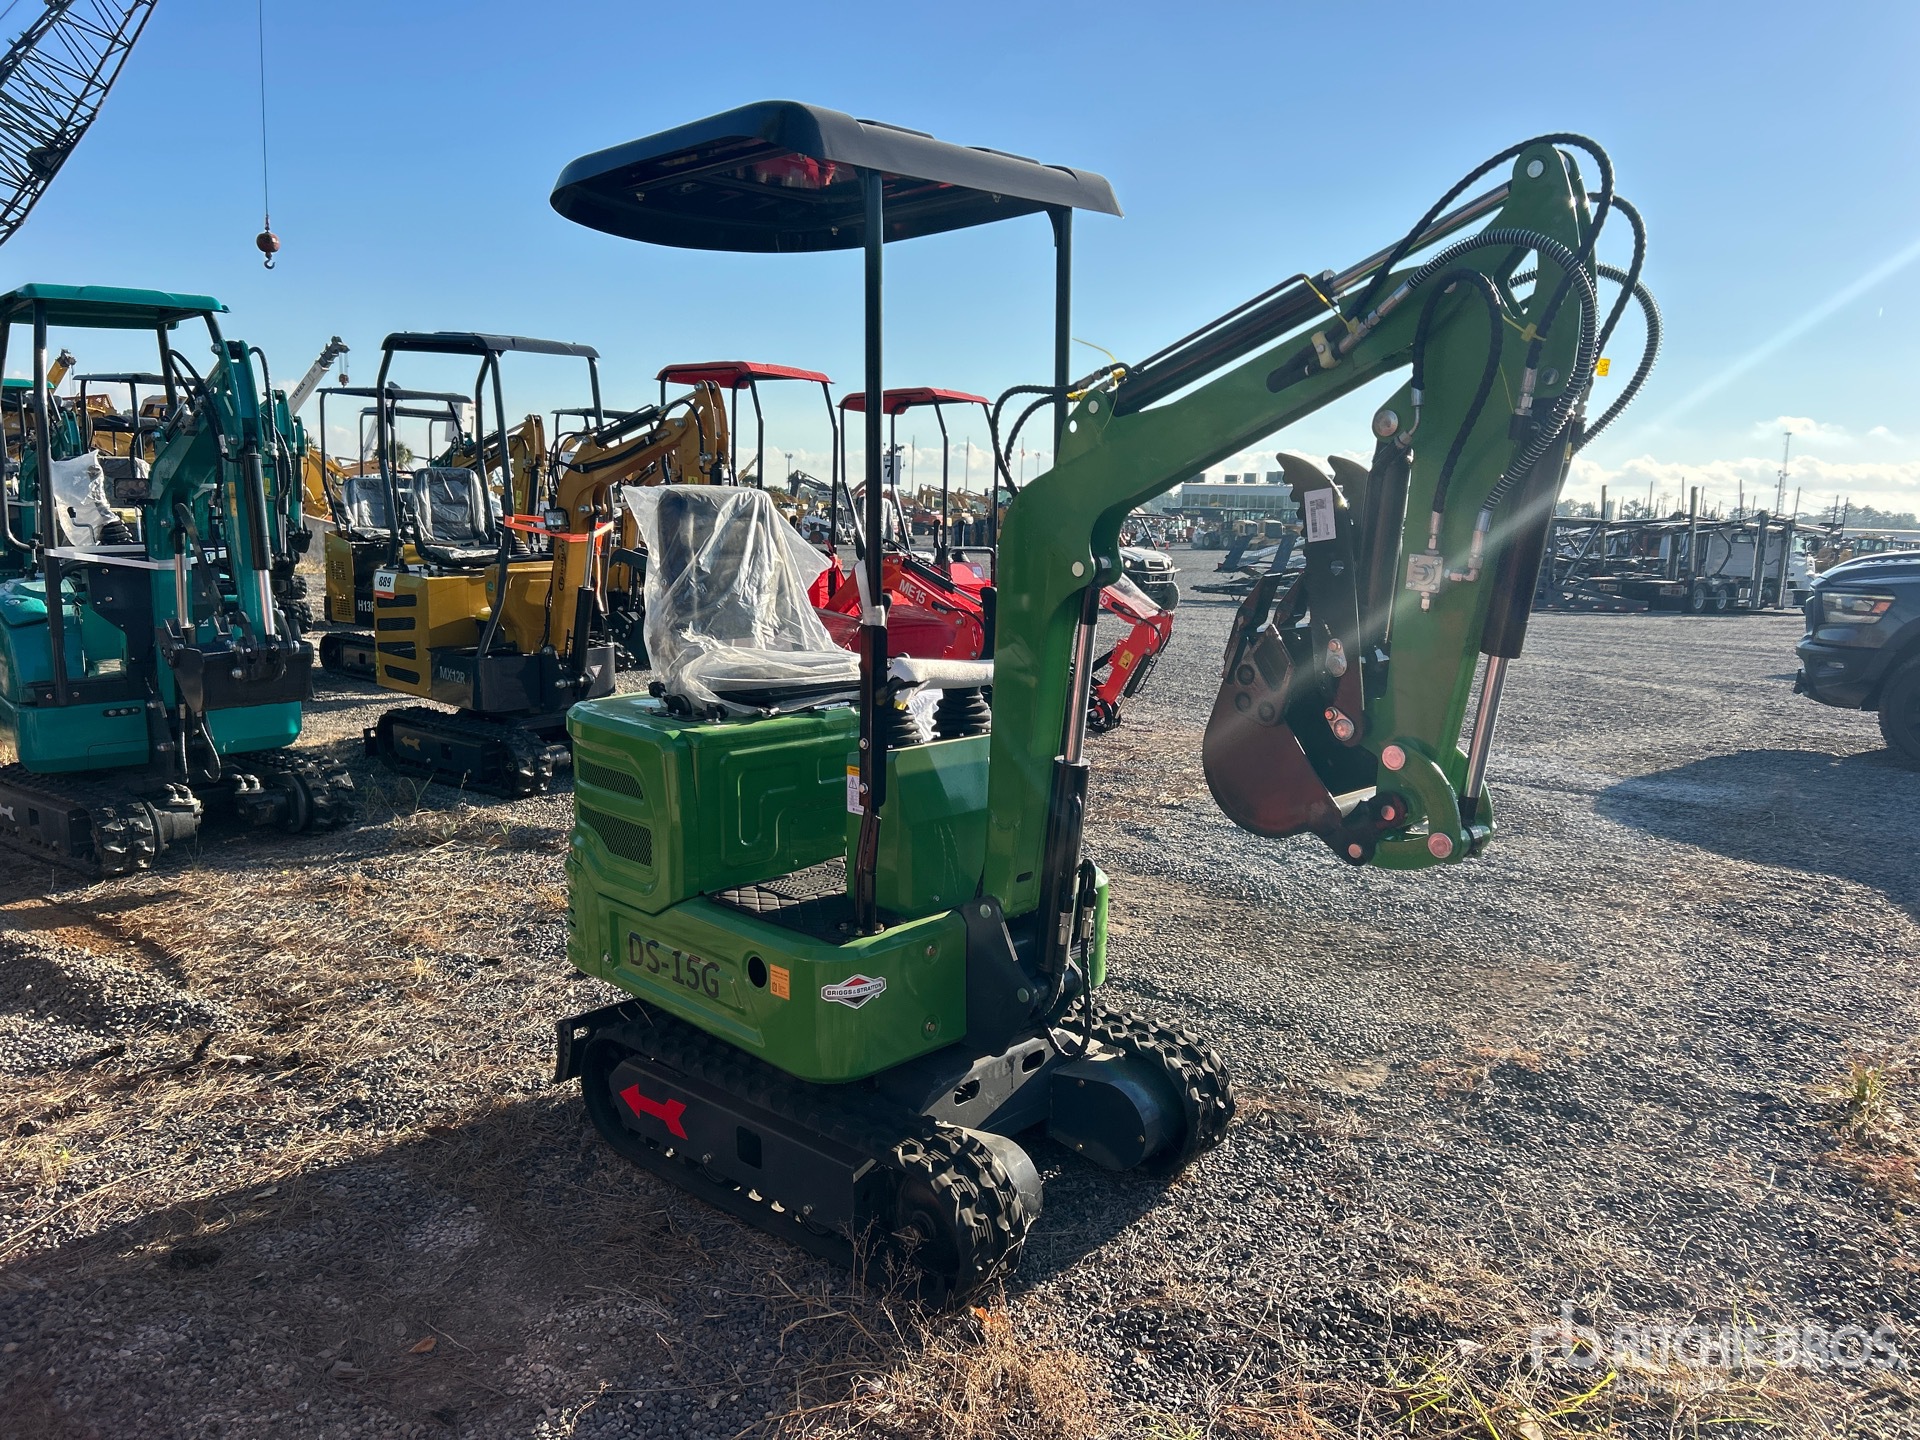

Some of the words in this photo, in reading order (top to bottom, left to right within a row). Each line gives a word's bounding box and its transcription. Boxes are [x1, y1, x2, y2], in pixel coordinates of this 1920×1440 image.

[292, 382, 306, 399] TEREX
[378, 575, 392, 588] 889
[628, 931, 721, 998] DS-15G
